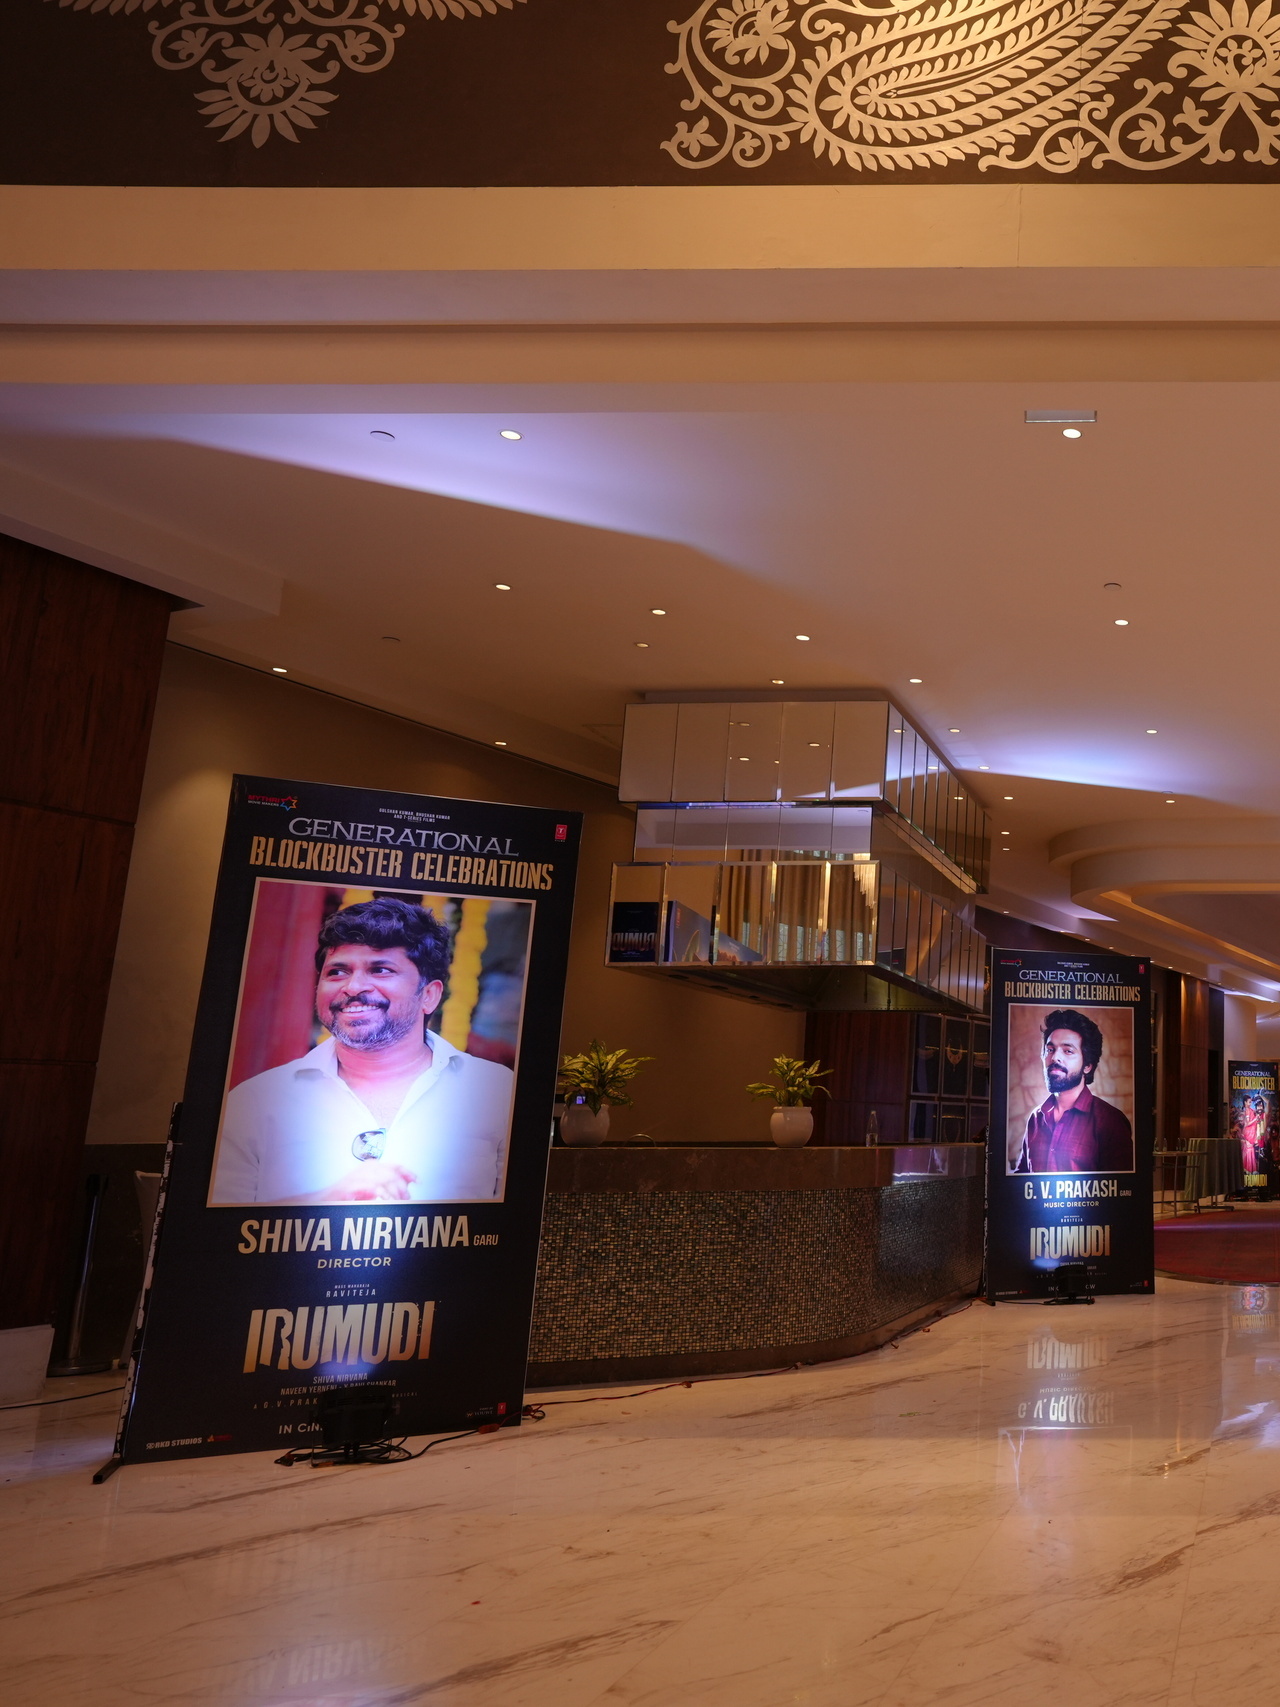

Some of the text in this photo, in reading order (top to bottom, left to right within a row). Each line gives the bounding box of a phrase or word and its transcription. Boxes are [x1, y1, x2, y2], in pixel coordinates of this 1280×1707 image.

[288, 817, 520, 857] GENERATIONAL
[249, 835, 554, 891] BLOCKBUSTER CELEBRATIONS
[1019, 969, 1124, 984] GENERATIONAL
[1004, 981, 1140, 1001] BLOCKBUSTER CELEBRATIONS
[1233, 1076, 1275, 1090] BLOCKBUSTER
[1024, 1182, 1037, 1200] G.
[1040, 1181, 1053, 1199] V.
[1056, 1179, 1118, 1199] PRAKASH
[1066, 1200, 1099, 1208] DIRECTOR
[237, 1215, 499, 1254] SHIVA NIRVANA GARU
[1030, 1225, 1111, 1260] IRUMUDI
[317, 1256, 392, 1270] DIRECTOR
[326, 1288, 376, 1298] RAVITEJA
[243, 1300, 437, 1374] IRUMUDI
[312, 1372, 368, 1384] SHIVA NIRVANA
[280, 1386, 307, 1396] NAVEEN
[278, 1425, 293, 1434] IN
[171, 1437, 202, 1447] STUDIOS
